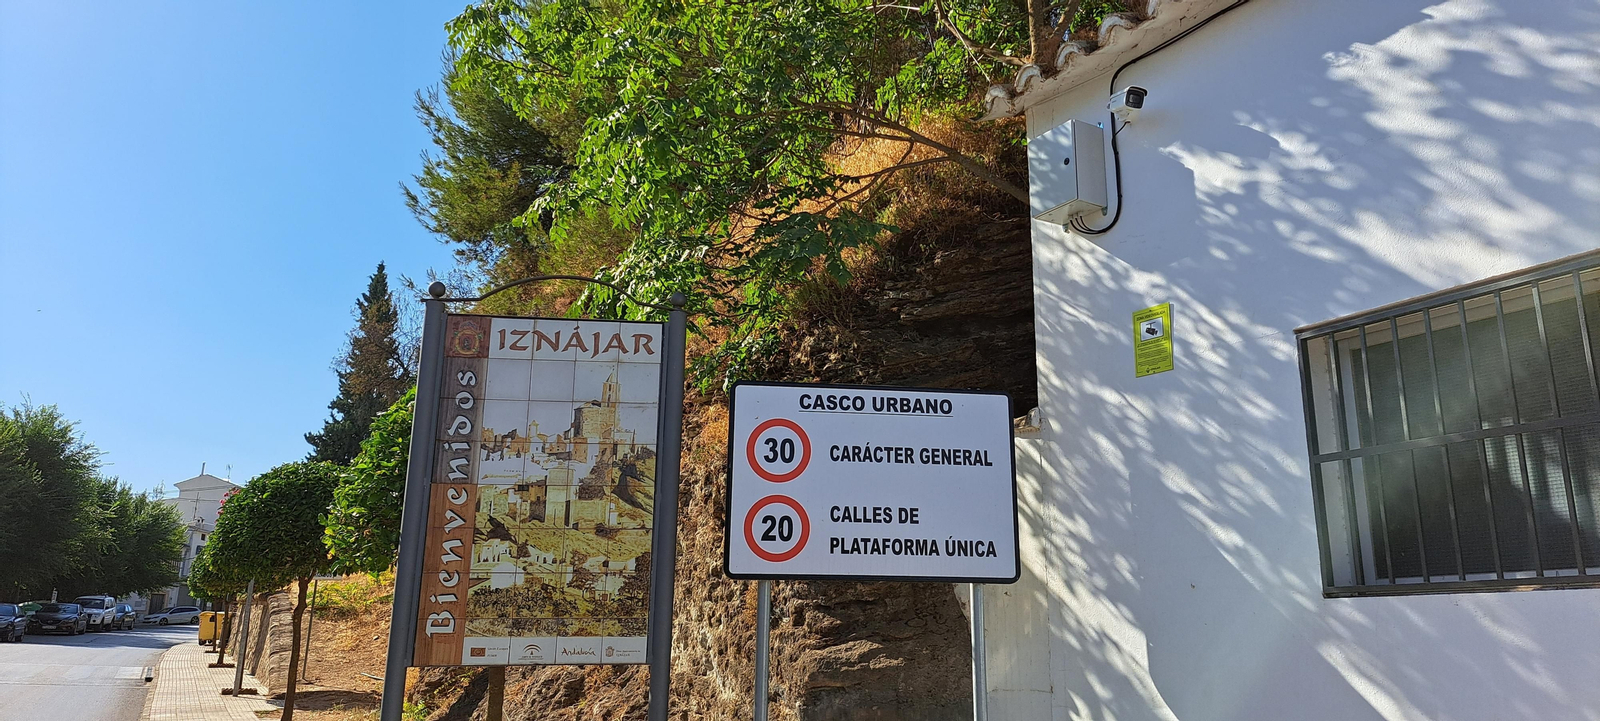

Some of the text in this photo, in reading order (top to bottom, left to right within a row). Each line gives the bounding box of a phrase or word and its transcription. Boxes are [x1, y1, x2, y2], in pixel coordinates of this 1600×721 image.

[497, 326, 655, 358] IZNÁJAR
[799, 393, 953, 415] CASCO URBANO
[763, 437, 795, 464] 30
[829, 442, 993, 467] CARÁCTER GENERAL
[425, 370, 477, 638] Bienvenidos
[829, 505, 920, 525] CALLES DE
[760, 515, 794, 542] 20
[829, 535, 997, 558] PLATAFORMA ÚNICA
